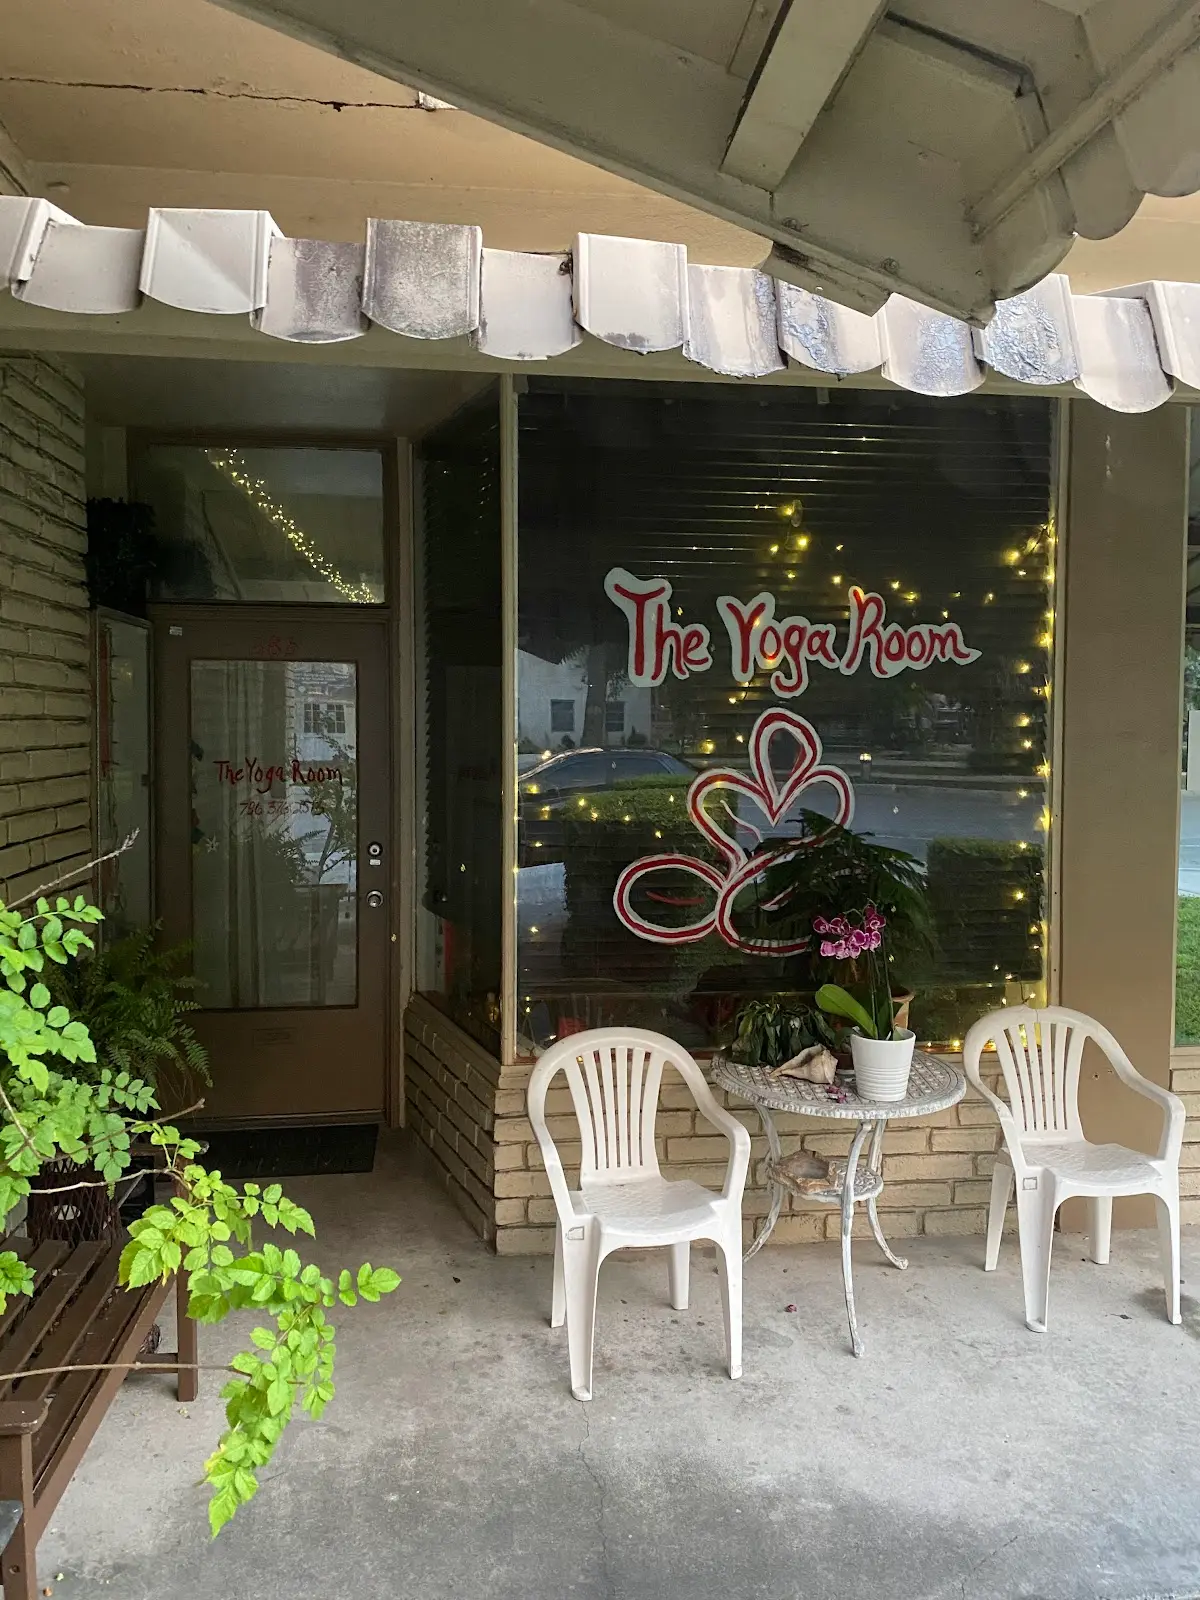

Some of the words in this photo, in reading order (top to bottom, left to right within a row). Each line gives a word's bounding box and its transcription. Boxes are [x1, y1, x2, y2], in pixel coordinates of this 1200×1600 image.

[612, 580, 711, 682] The
[724, 600, 836, 694] Yoga
[844, 588, 972, 677] Room
[213, 760, 244, 785] The
[245, 757, 286, 793] Yoga
[292, 759, 343, 786] Room
